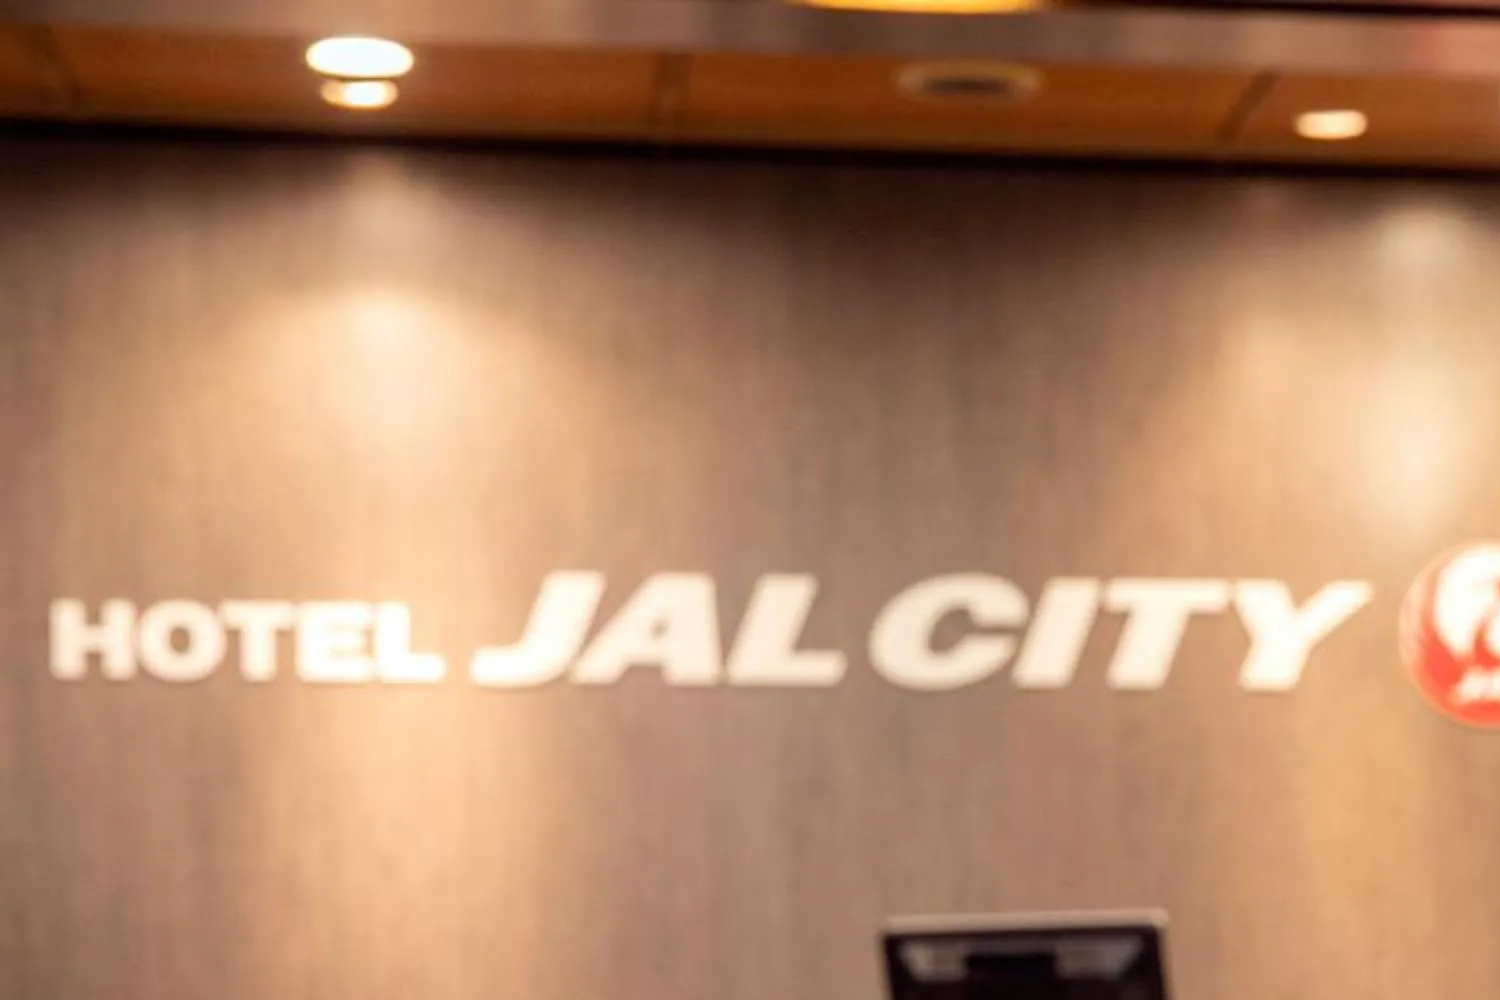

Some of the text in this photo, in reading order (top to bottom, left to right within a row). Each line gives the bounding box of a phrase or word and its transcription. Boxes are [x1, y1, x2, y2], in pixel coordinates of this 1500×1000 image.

[49, 569, 1374, 691] HOTEL JAL CITY
